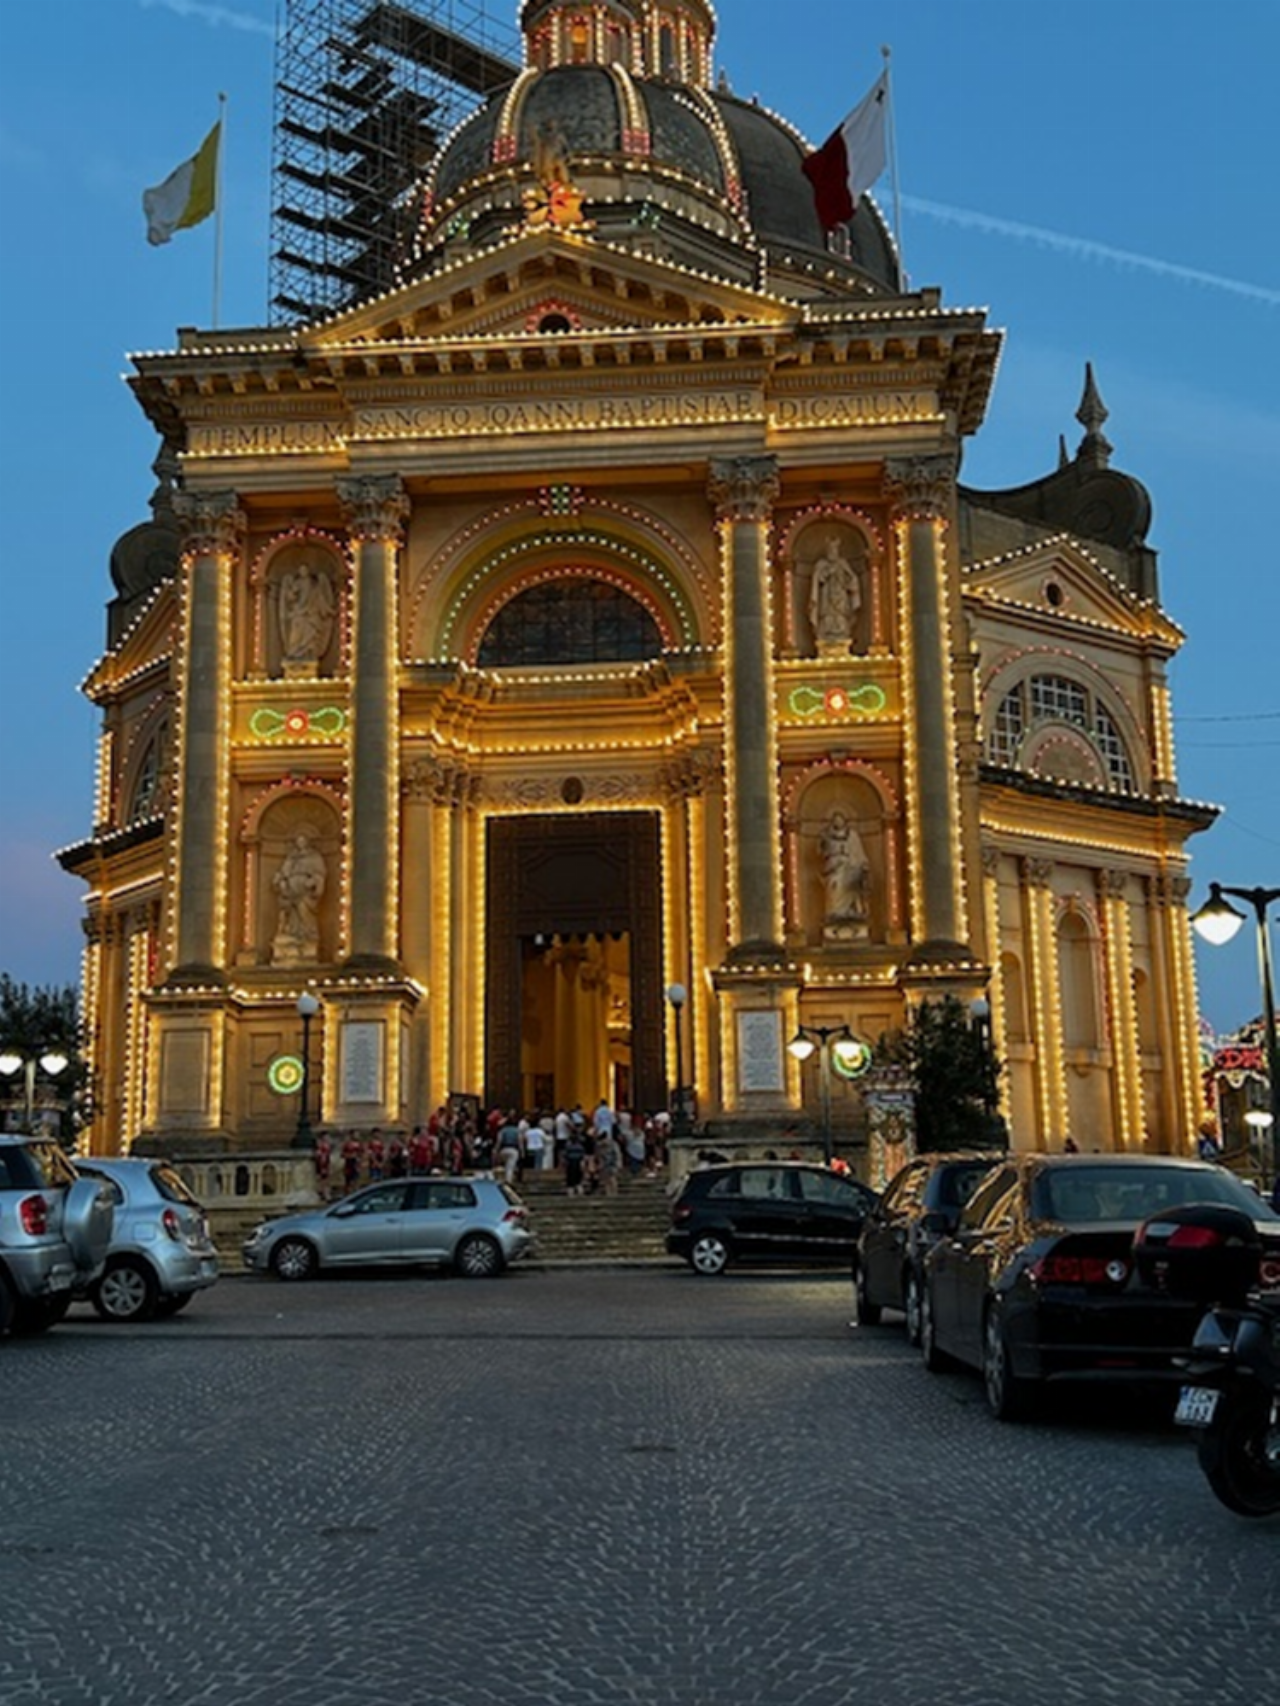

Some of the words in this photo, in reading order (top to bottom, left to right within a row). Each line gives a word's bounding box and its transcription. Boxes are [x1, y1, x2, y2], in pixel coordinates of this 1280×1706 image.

[359, 406, 470, 433] SANCTO
[599, 392, 752, 421] BAPTISTAE
[778, 394, 918, 421] DICATUM
